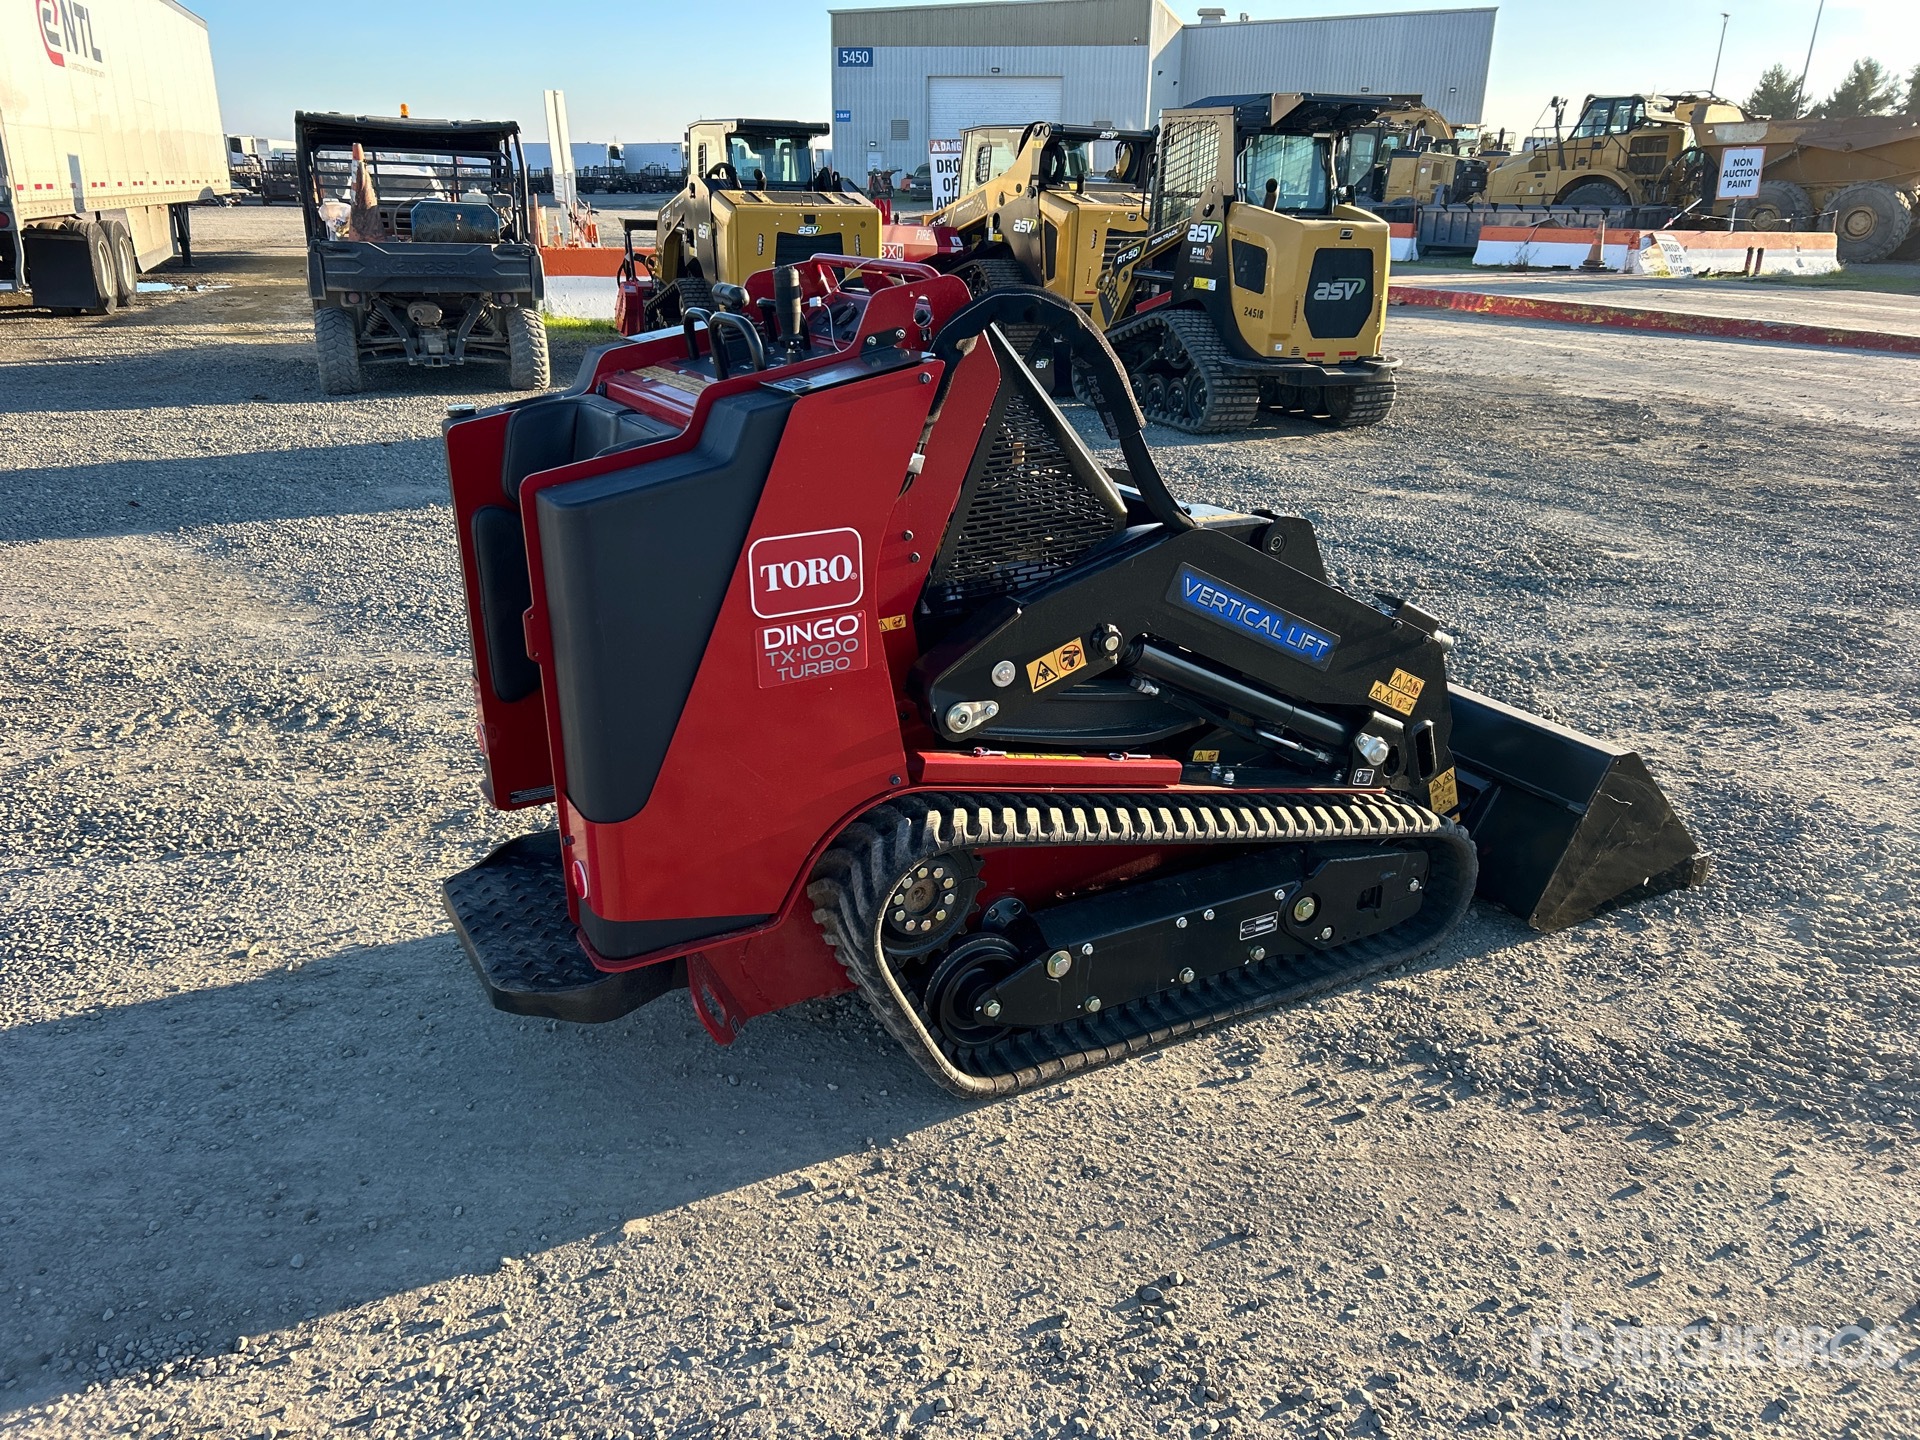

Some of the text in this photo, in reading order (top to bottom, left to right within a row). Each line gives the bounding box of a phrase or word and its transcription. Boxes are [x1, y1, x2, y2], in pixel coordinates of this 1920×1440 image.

[842, 51, 869, 64] 5450
[940, 141, 962, 152] DANG
[936, 159, 960, 173] DRO
[1733, 158, 1753, 167] NON
[1723, 168, 1760, 179] AUCTION
[943, 177, 958, 192] OF
[1727, 180, 1752, 188] PAINT
[797, 225, 819, 235] asv
[1013, 218, 1034, 233] asv
[1187, 223, 1218, 243] asv
[1191, 247, 1206, 256] FMI
[1661, 243, 1680, 253] DROP
[1116, 248, 1139, 265] RT-50
[1669, 254, 1684, 264] OFF
[382, 258, 478, 275] Kawasaki
[1313, 281, 1360, 301] asv
[1243, 306, 1265, 320] 24518
[760, 554, 853, 593] TORO
[1184, 577, 1329, 657] VERTICAL LIFT
[763, 614, 859, 650] DINGO
[776, 656, 851, 681] TURBO
